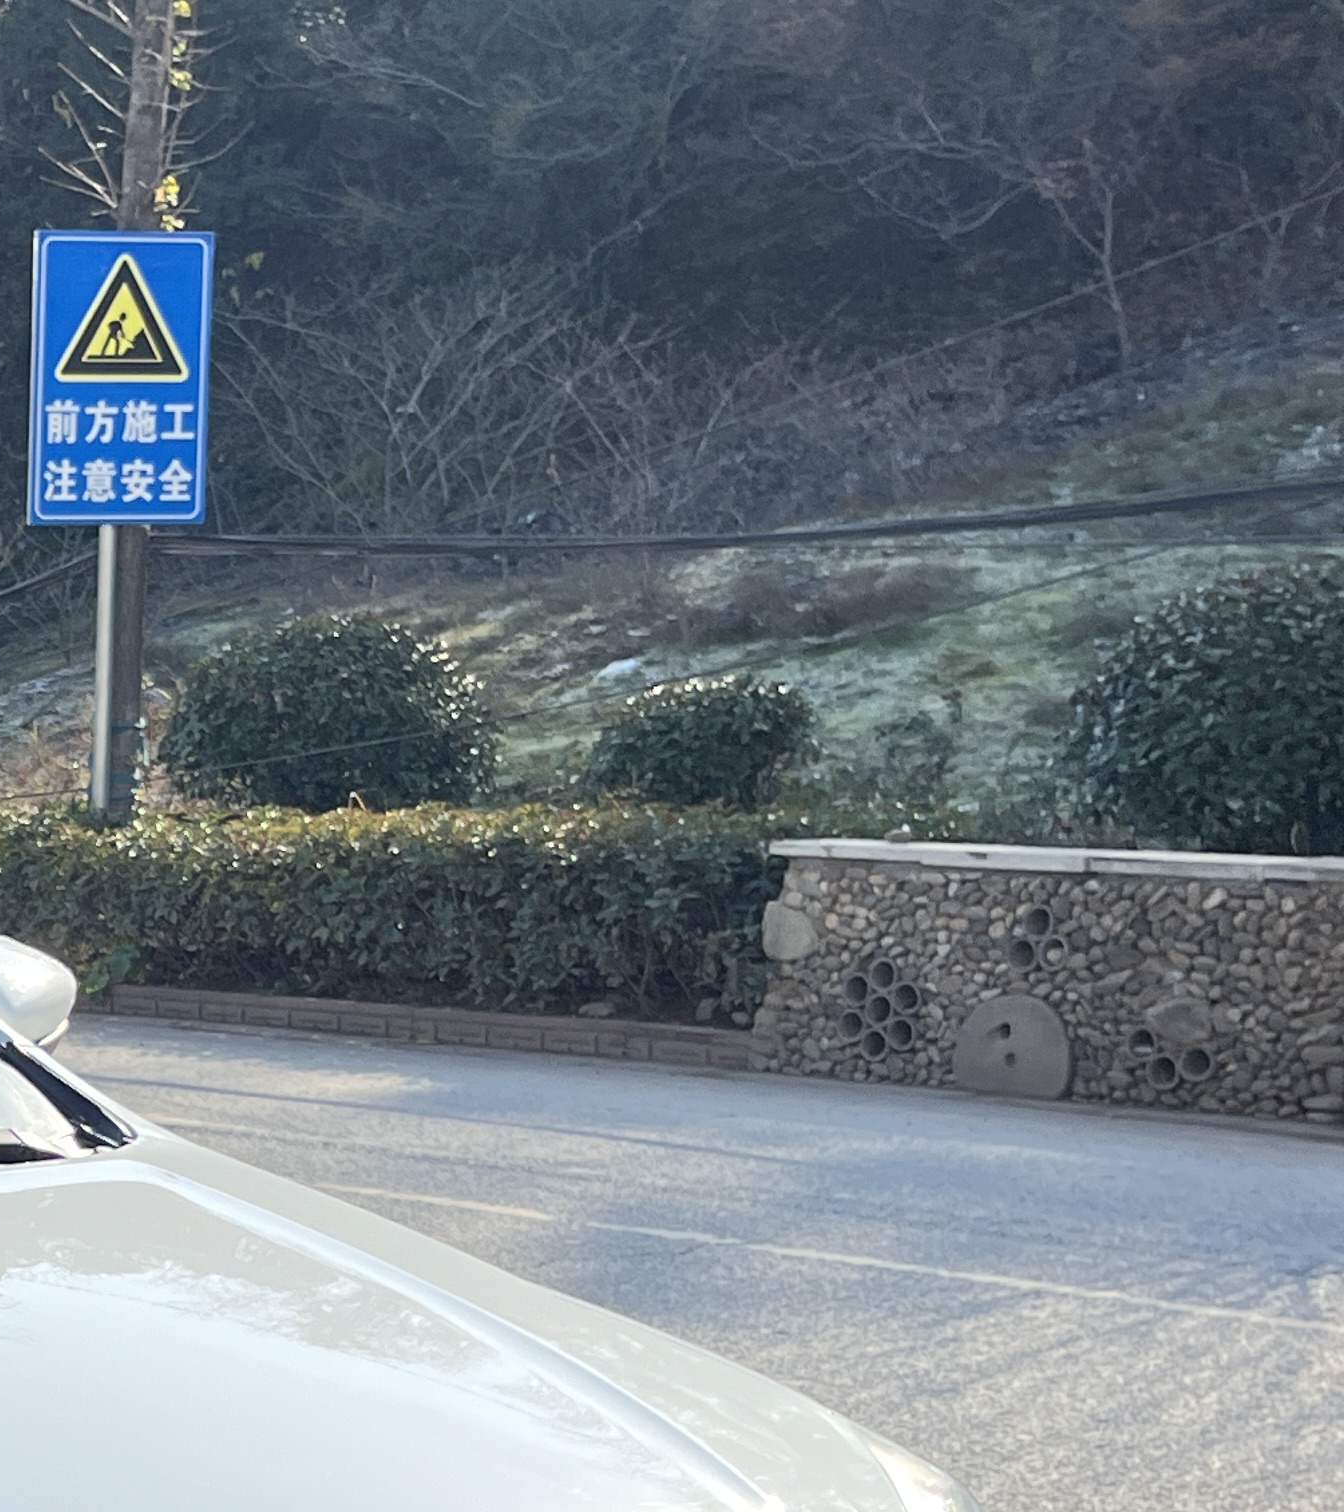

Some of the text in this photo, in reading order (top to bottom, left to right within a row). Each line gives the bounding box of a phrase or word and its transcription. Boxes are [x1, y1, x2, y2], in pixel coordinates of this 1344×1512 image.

[45, 399, 195, 444] 前方施工
[43, 458, 193, 503] 注意安全
